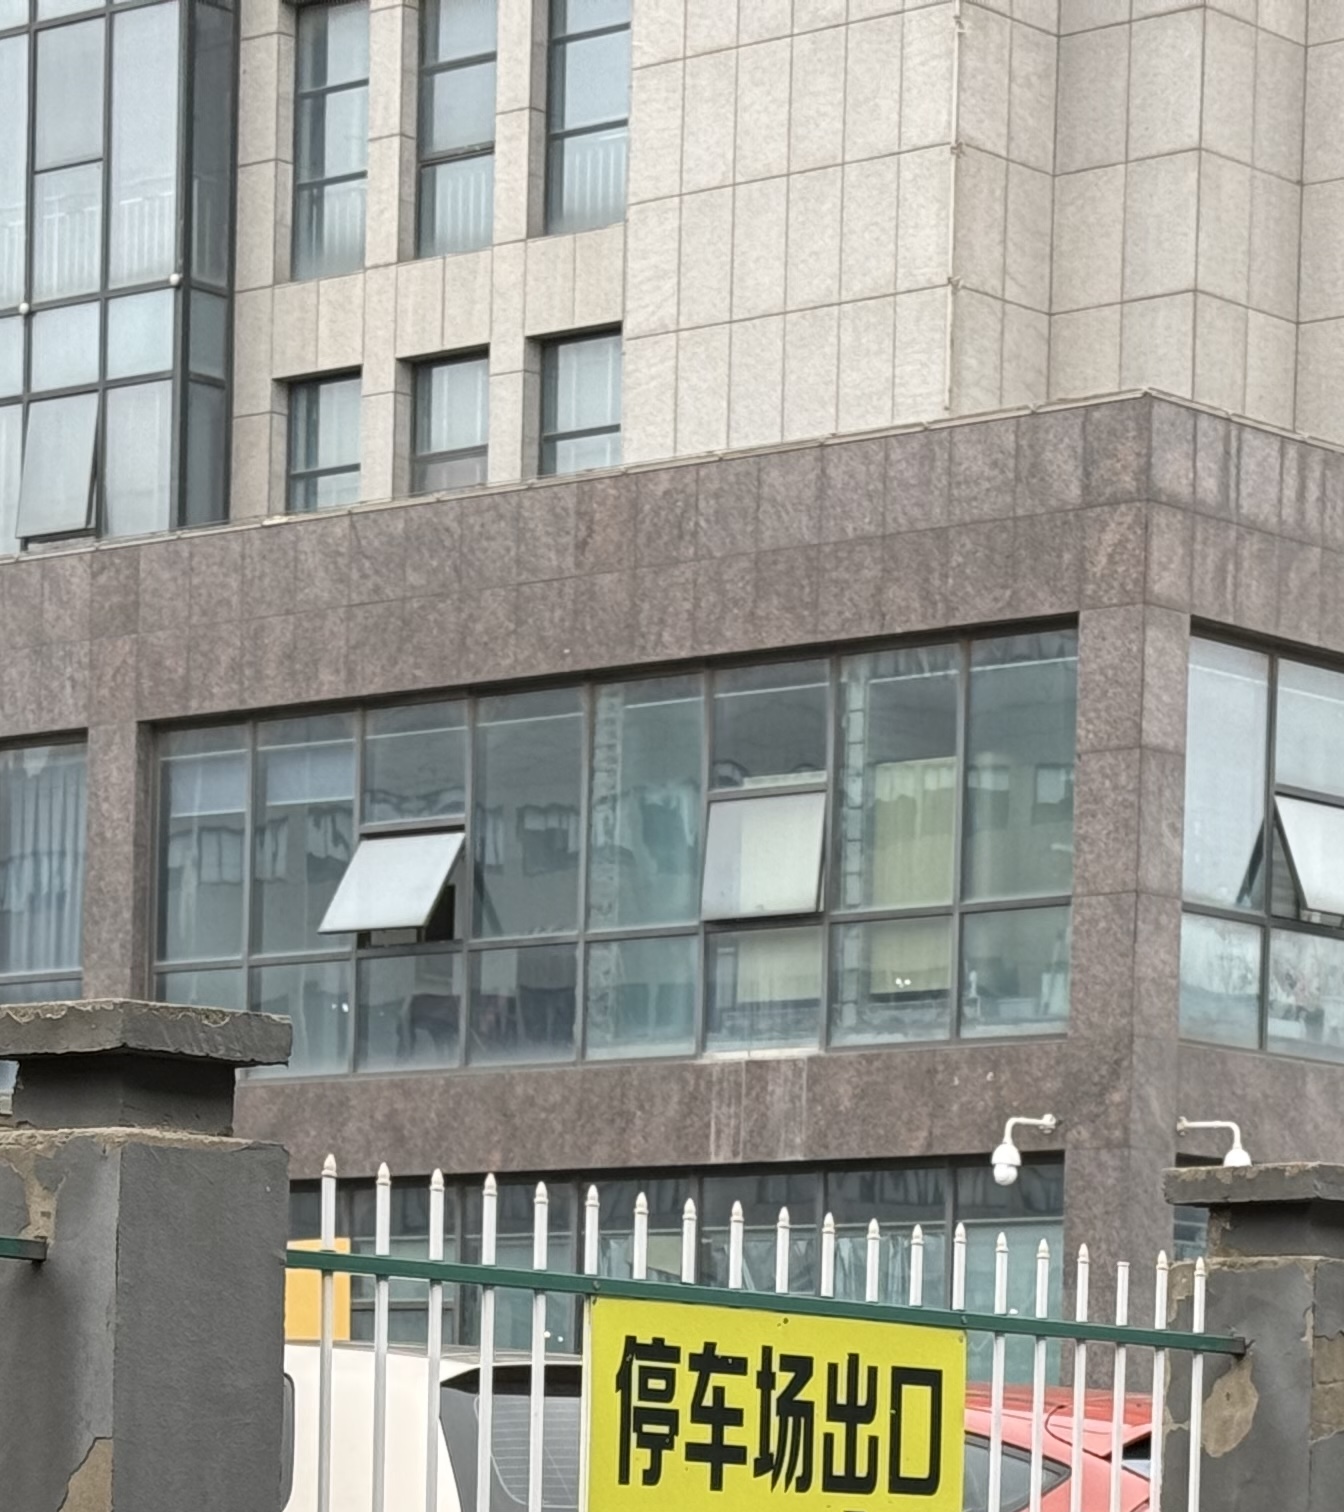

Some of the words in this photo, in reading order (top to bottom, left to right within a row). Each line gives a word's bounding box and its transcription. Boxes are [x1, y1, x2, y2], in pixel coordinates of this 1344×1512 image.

[615, 1335, 943, 1496] 停车场出口
